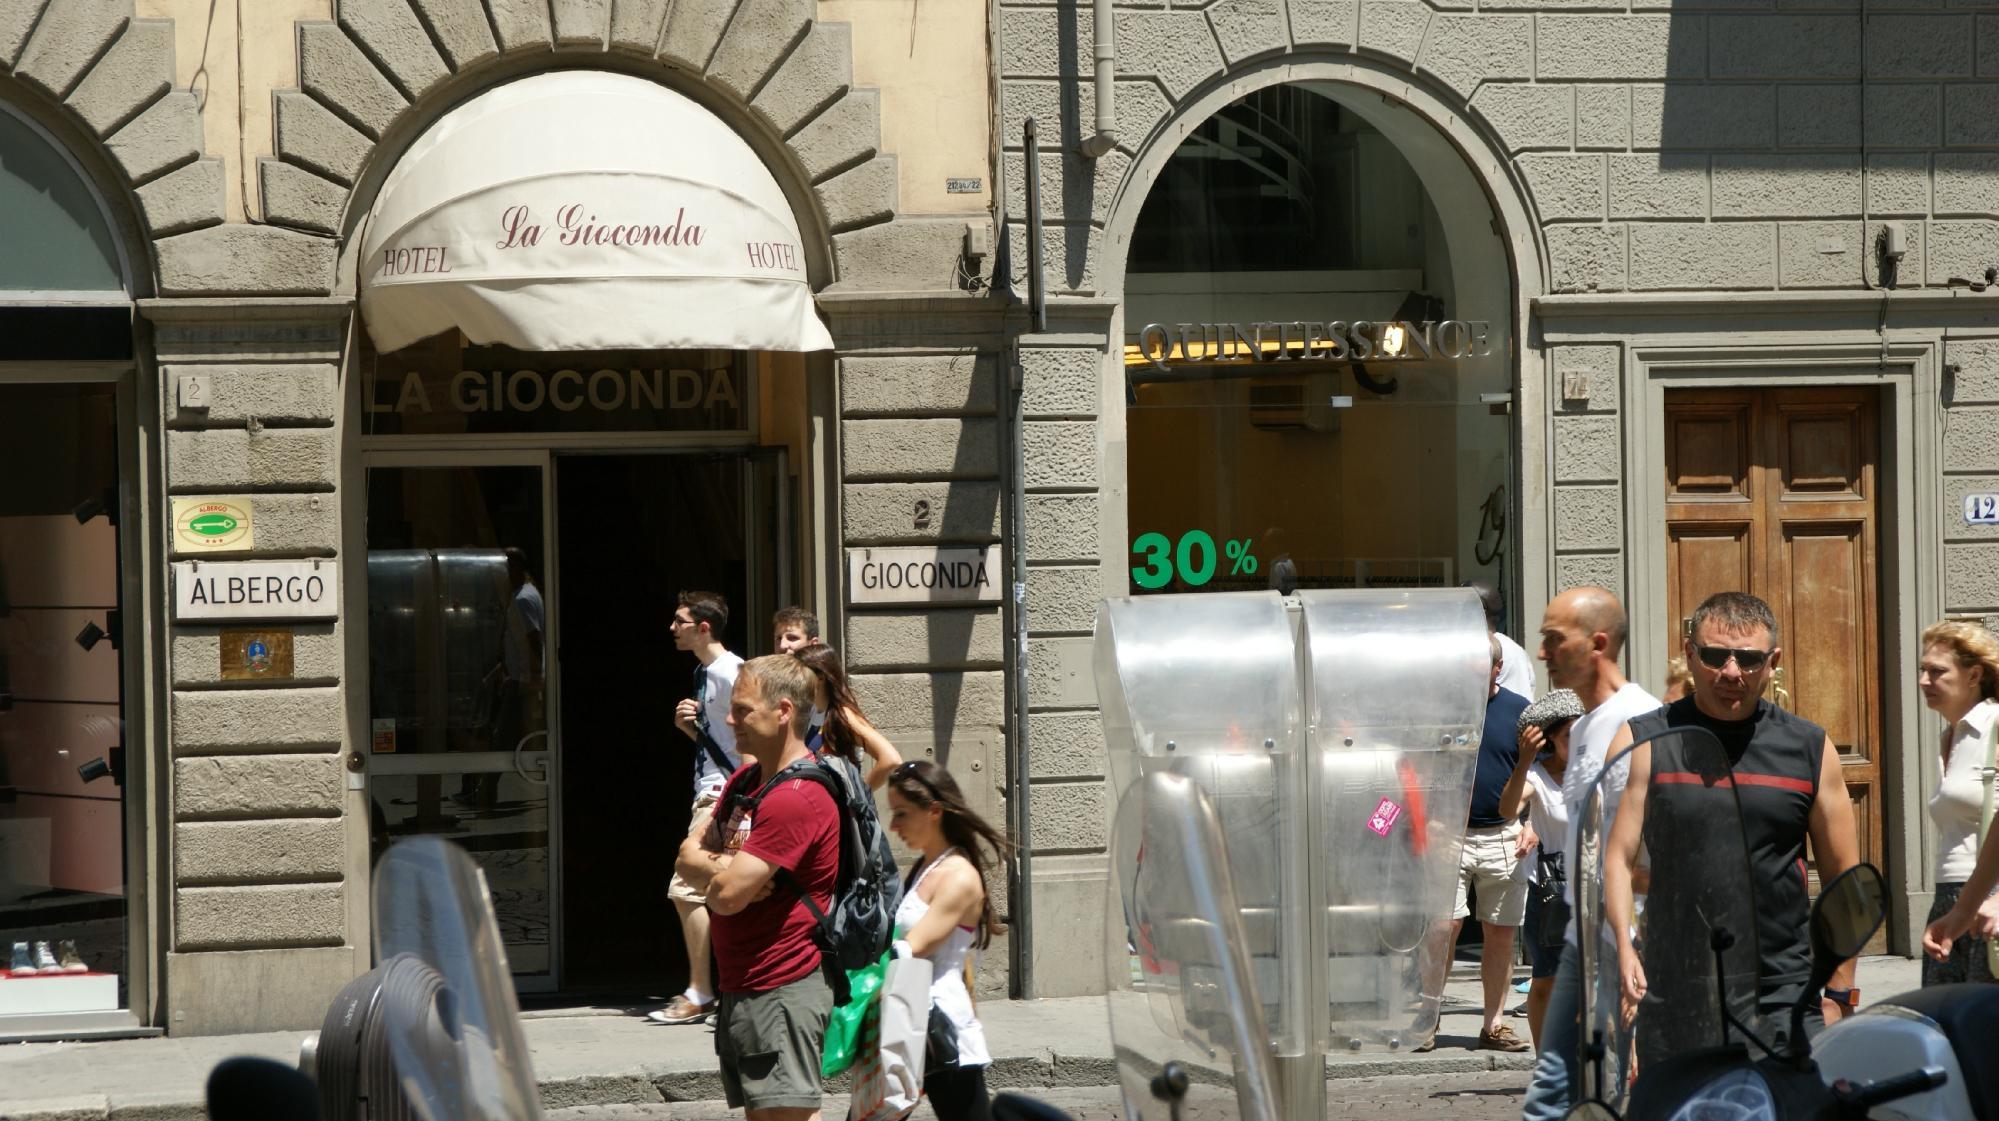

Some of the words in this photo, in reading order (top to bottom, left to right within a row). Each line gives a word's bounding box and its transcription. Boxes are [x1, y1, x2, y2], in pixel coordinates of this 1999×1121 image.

[496, 205, 549, 249] La
[557, 204, 707, 246] Gioconda
[383, 247, 452, 277] HOTEL
[746, 242, 799, 271] HOTEL
[1140, 319, 1492, 372] QUINTESSENCE
[188, 383, 200, 400] 2
[362, 371, 433, 413] LA
[450, 369, 738, 413] GIOCONDA
[199, 505, 228, 513] ALBERGO
[913, 499, 931, 526] 2
[1971, 496, 1996, 519] 12
[190, 575, 324, 605] ALBERGO
[861, 561, 990, 590] GIOCONDA
